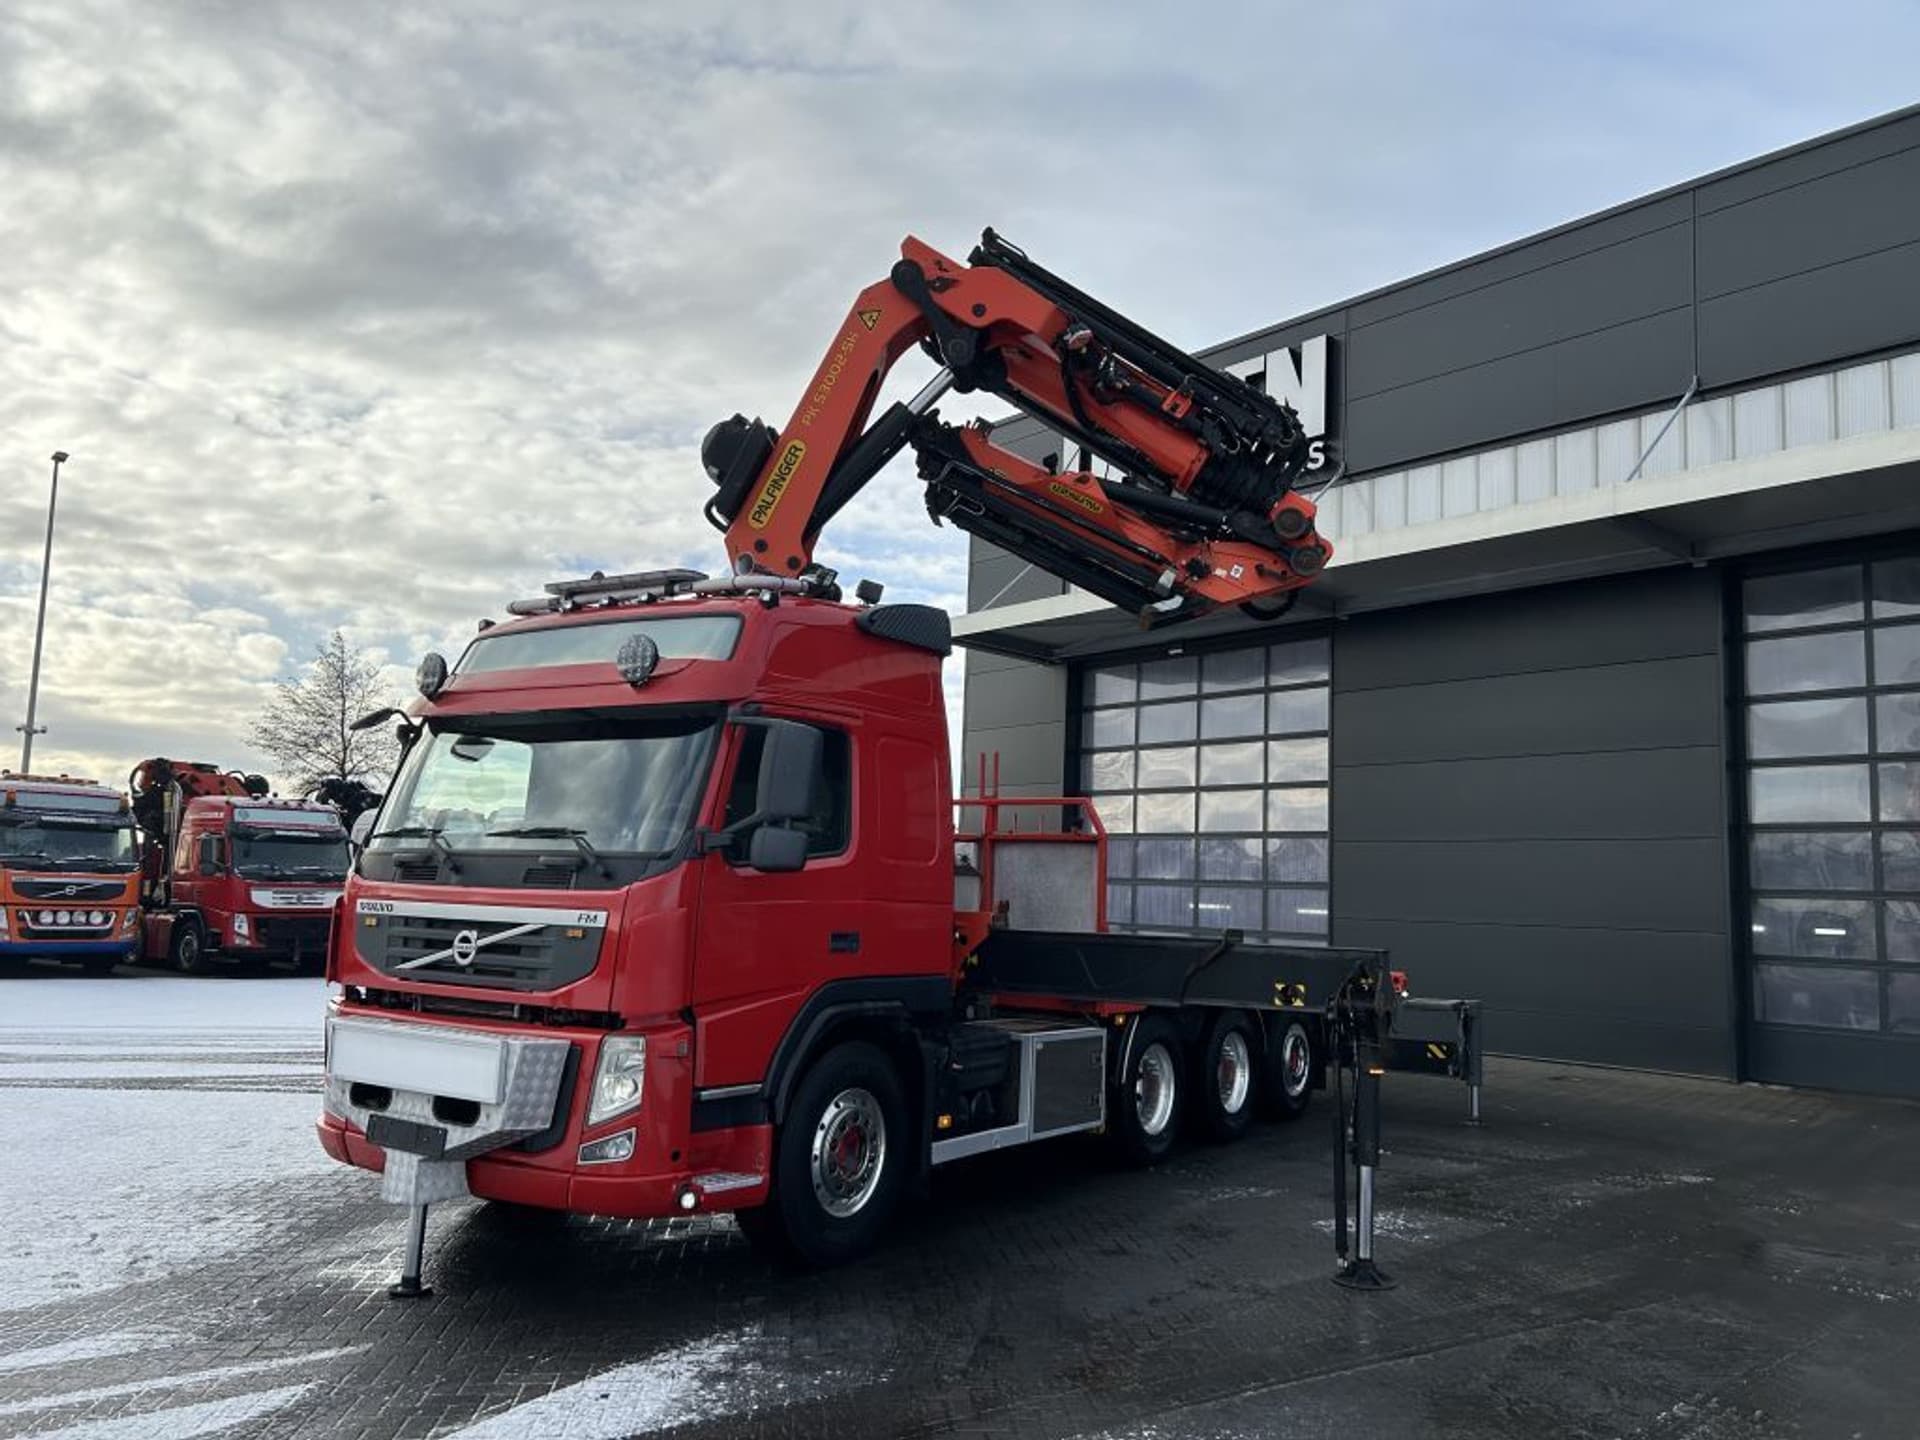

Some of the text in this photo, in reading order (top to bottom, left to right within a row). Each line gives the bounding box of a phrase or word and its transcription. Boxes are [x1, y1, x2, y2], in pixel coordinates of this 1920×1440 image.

[802, 405, 819, 425] PK
[751, 444, 804, 525] PALFINGER
[360, 902, 598, 923] VOLVO FM
